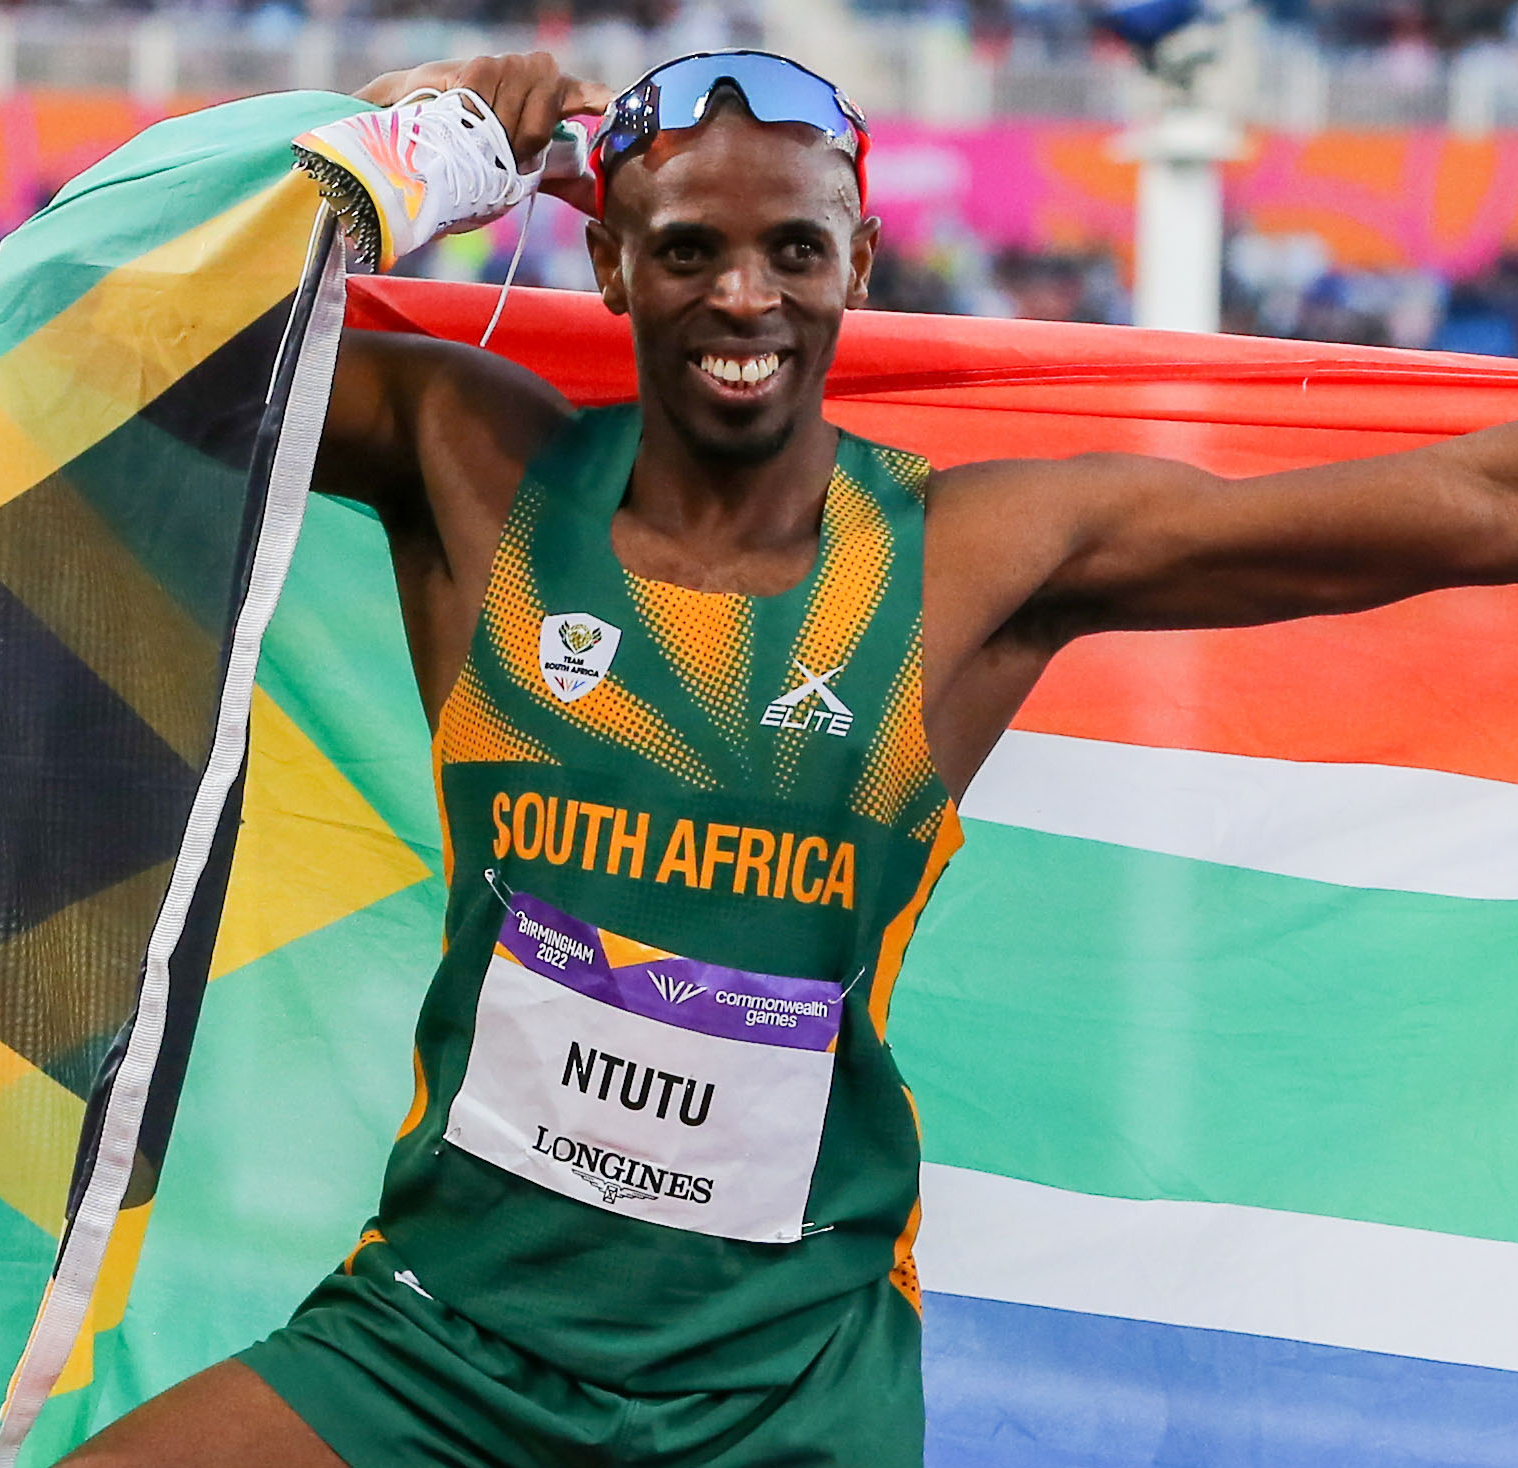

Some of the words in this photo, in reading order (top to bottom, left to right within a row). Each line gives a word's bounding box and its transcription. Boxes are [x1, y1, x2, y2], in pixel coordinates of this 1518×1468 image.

[544, 662, 570, 671] SOUTH
[571, 666, 599, 677] AFRICA
[564, 656, 584, 665] TEAM
[760, 703, 854, 737] ELITE
[492, 791, 651, 880] SOUTH
[655, 818, 856, 910] AFRICA
[518, 917, 594, 965] BIRMINGHAM
[536, 943, 569, 971] 2022
[715, 989, 829, 1018] commonwealth
[745, 1008, 799, 1028] games
[561, 1041, 716, 1127] NTUTU
[532, 1125, 714, 1204] LONGINES
